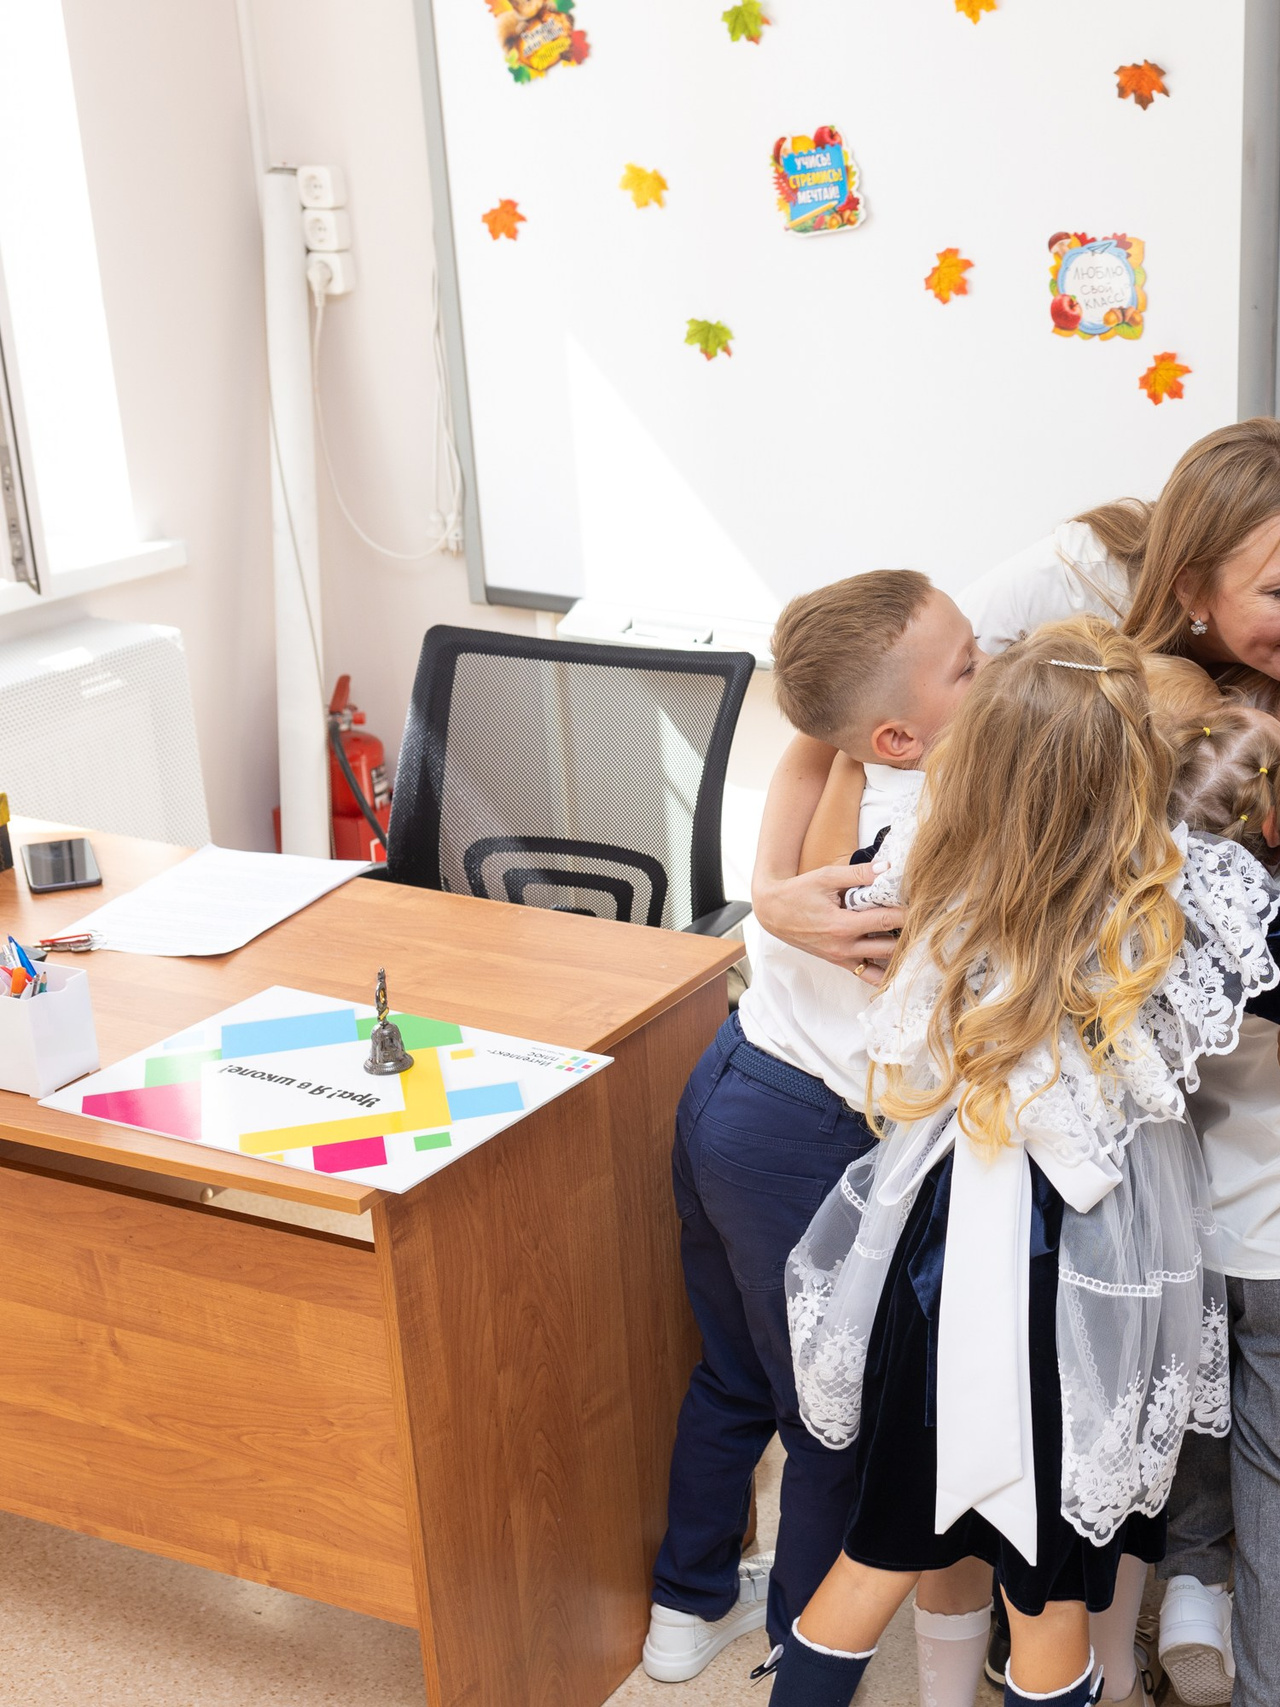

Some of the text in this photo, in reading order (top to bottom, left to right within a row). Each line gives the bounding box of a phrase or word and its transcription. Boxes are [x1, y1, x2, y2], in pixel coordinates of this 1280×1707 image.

[794, 152, 832, 171] УЧИСЬ!
[789, 167, 844, 189] СТРЕМИСЬ!
[797, 183, 841, 205] МЕЧТАЙ!
[1073, 265, 1124, 280] ЛЮБЛЮ
[219, 1064, 381, 1108] Ура! Я в школе!
[1168, 1583, 1196, 1595] adidas
